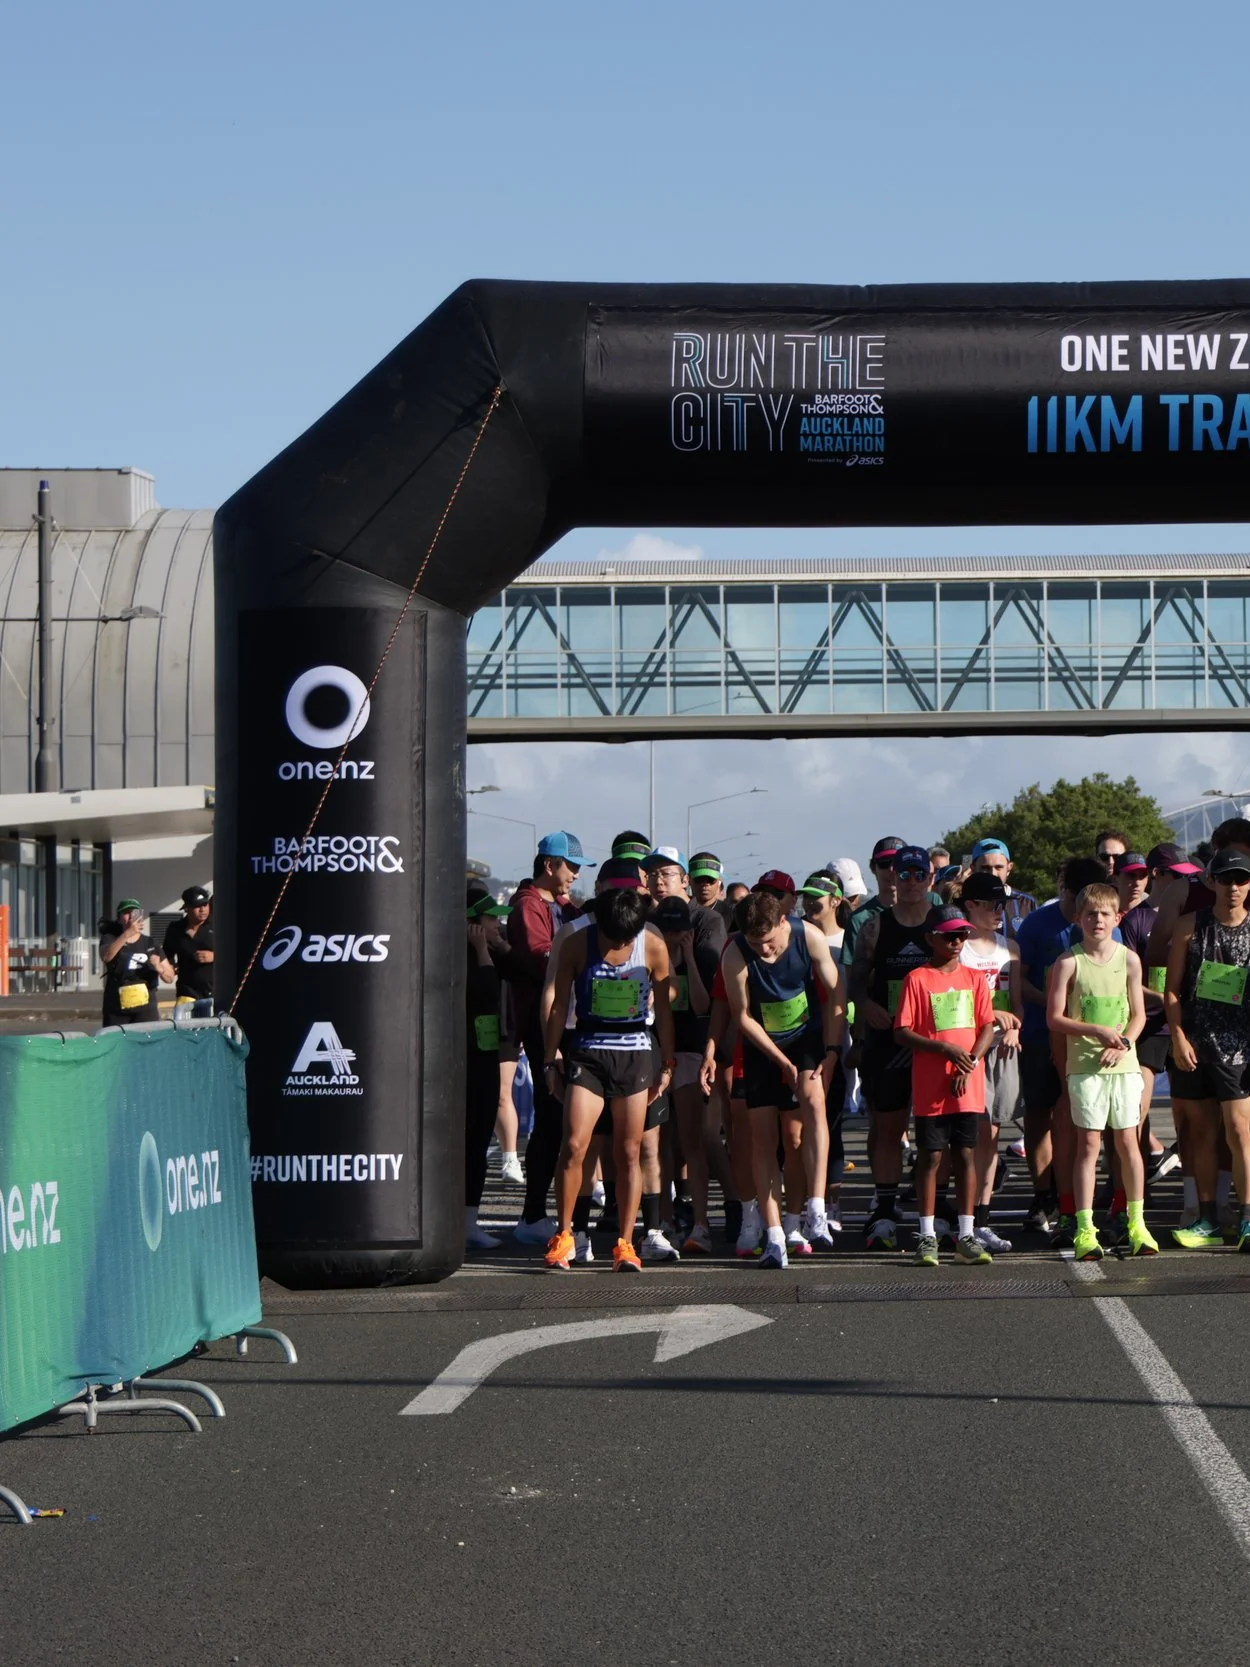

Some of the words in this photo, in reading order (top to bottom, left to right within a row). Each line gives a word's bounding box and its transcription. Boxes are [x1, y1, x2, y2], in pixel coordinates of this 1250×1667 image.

[671, 333, 776, 389] RUN
[784, 334, 886, 390] THE
[1060, 335, 1130, 372] ONE
[1141, 334, 1220, 371] NEW
[815, 394, 870, 404] BARFOOT
[800, 404, 869, 415] THOMPSON
[671, 392, 794, 452] CITY
[800, 417, 885, 435] AUCKLAND
[1027, 395, 1143, 453] 11KM
[800, 435, 885, 452] MARATHON
[278, 761, 375, 781] one.nz
[275, 836, 379, 854] BARFOOT
[251, 855, 377, 874] THOMPSON
[286, 1074, 360, 1085] AUCKLAND
[315, 1086, 364, 1096] MAKAURAU
[250, 1154, 403, 1182] #RUNTHECITY
[166, 1150, 222, 1216] one.nz
